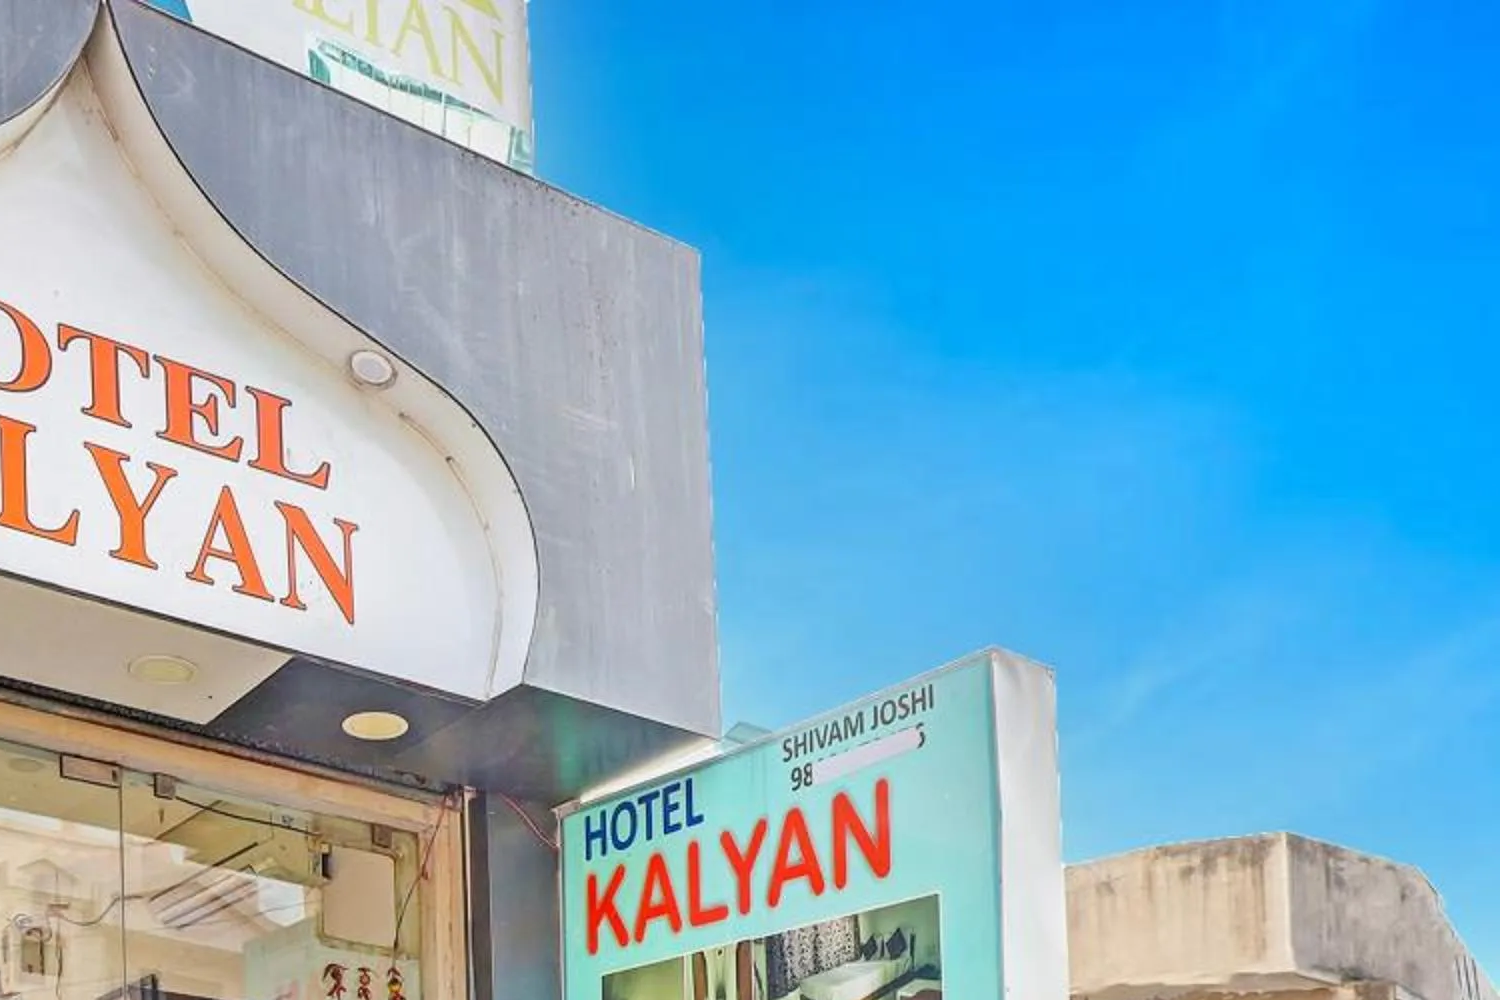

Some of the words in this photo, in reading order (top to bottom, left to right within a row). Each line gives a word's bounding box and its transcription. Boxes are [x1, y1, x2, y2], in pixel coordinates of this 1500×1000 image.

[292, 0, 505, 105] AN
[782, 711, 864, 763] SHIVAM
[871, 684, 934, 730] JOSHI
[583, 776, 705, 862] HOTEL
[585, 777, 891, 956] KALYAN
